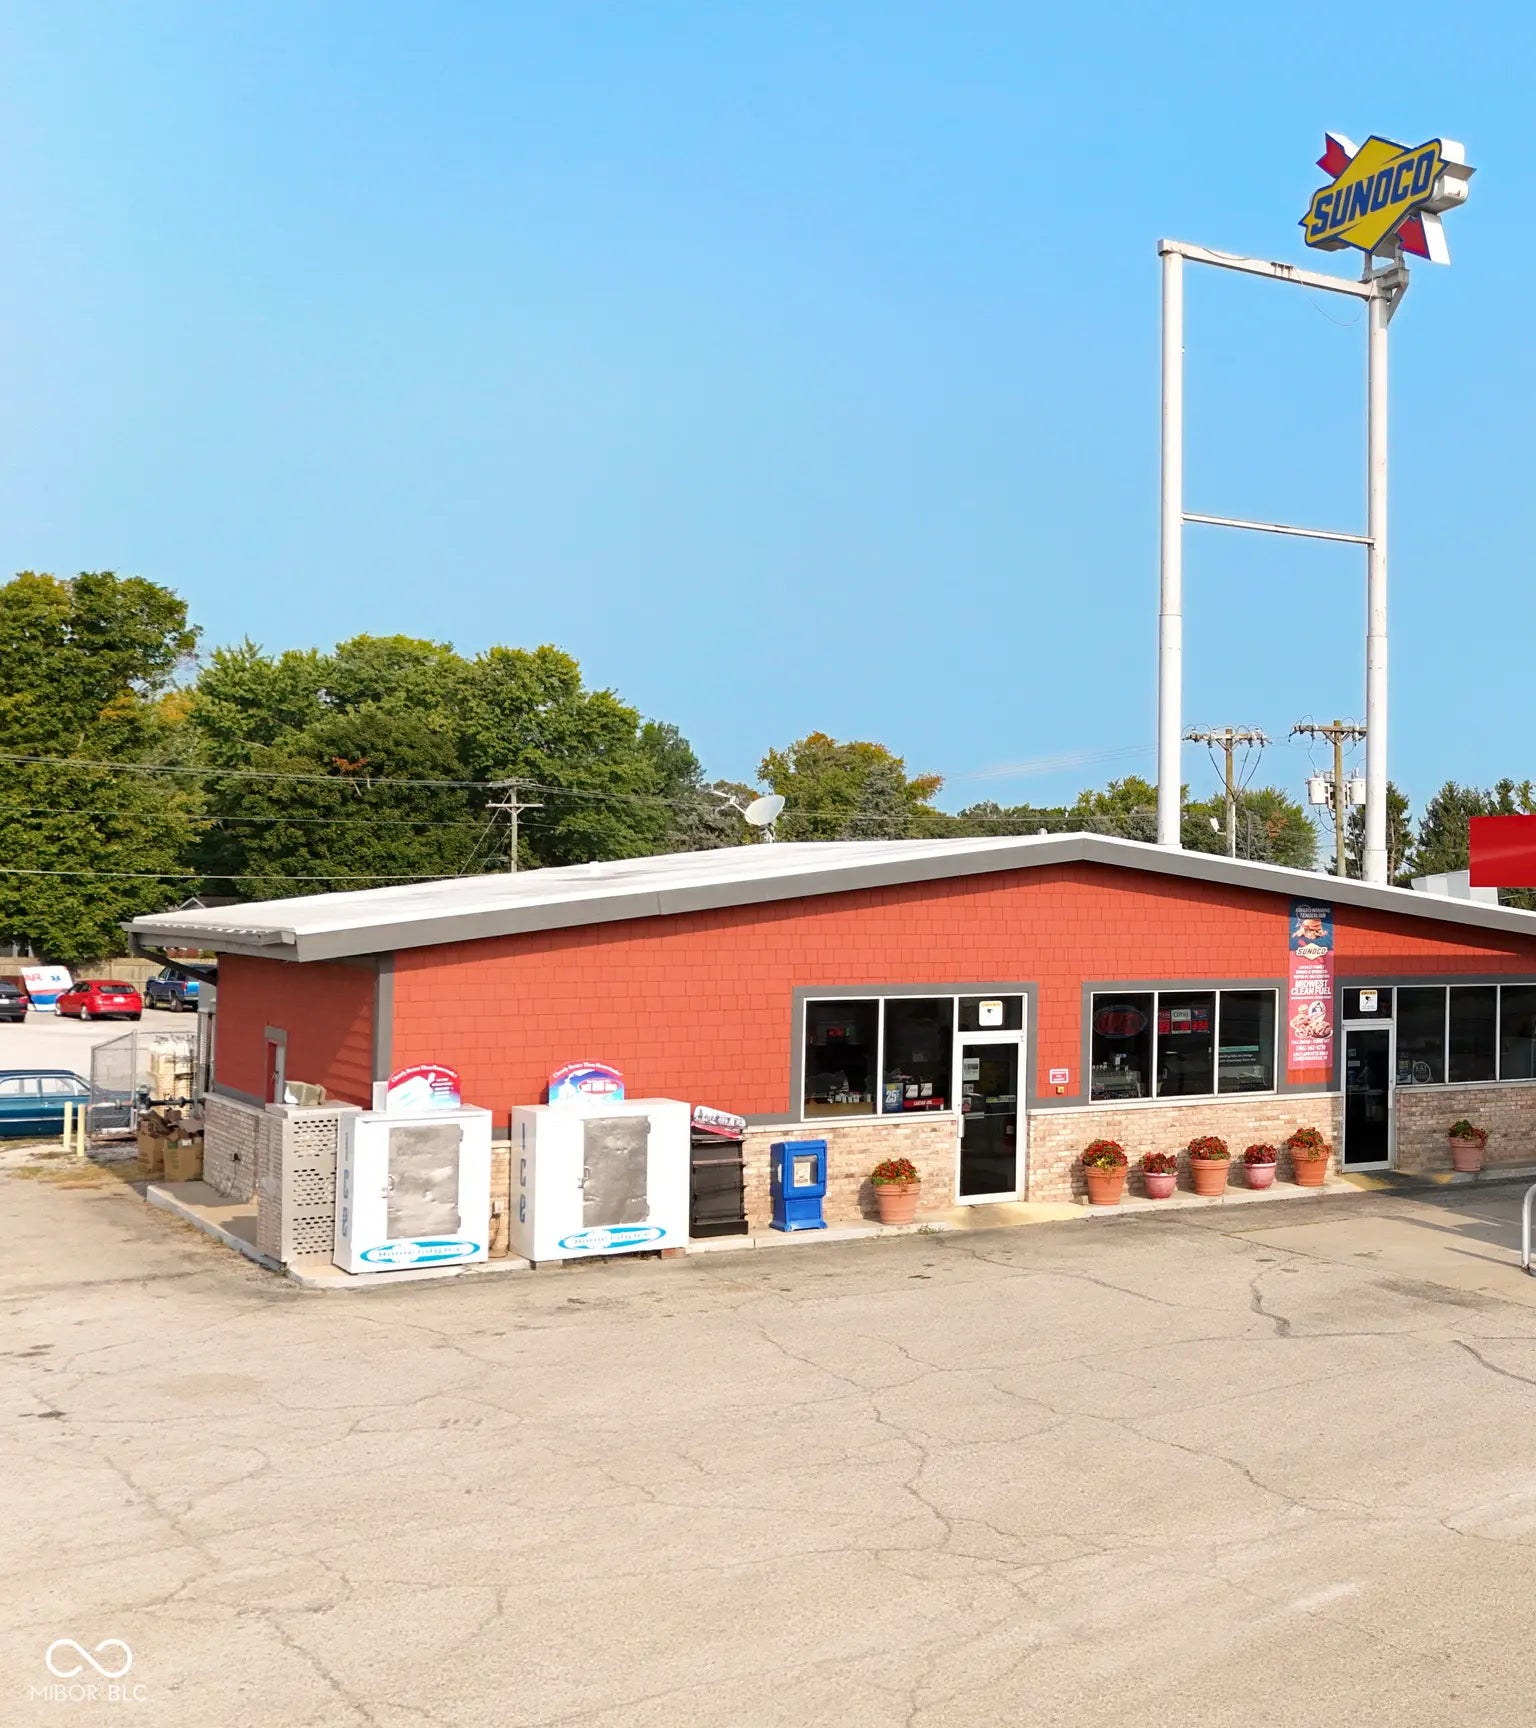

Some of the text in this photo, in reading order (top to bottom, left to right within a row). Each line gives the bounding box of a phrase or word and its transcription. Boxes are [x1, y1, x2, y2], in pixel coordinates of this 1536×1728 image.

[1311, 149, 1435, 237] SUNOCO
[1295, 980, 1329, 988] MIDWEST
[1291, 987, 1332, 995] CLEAN FUEL
